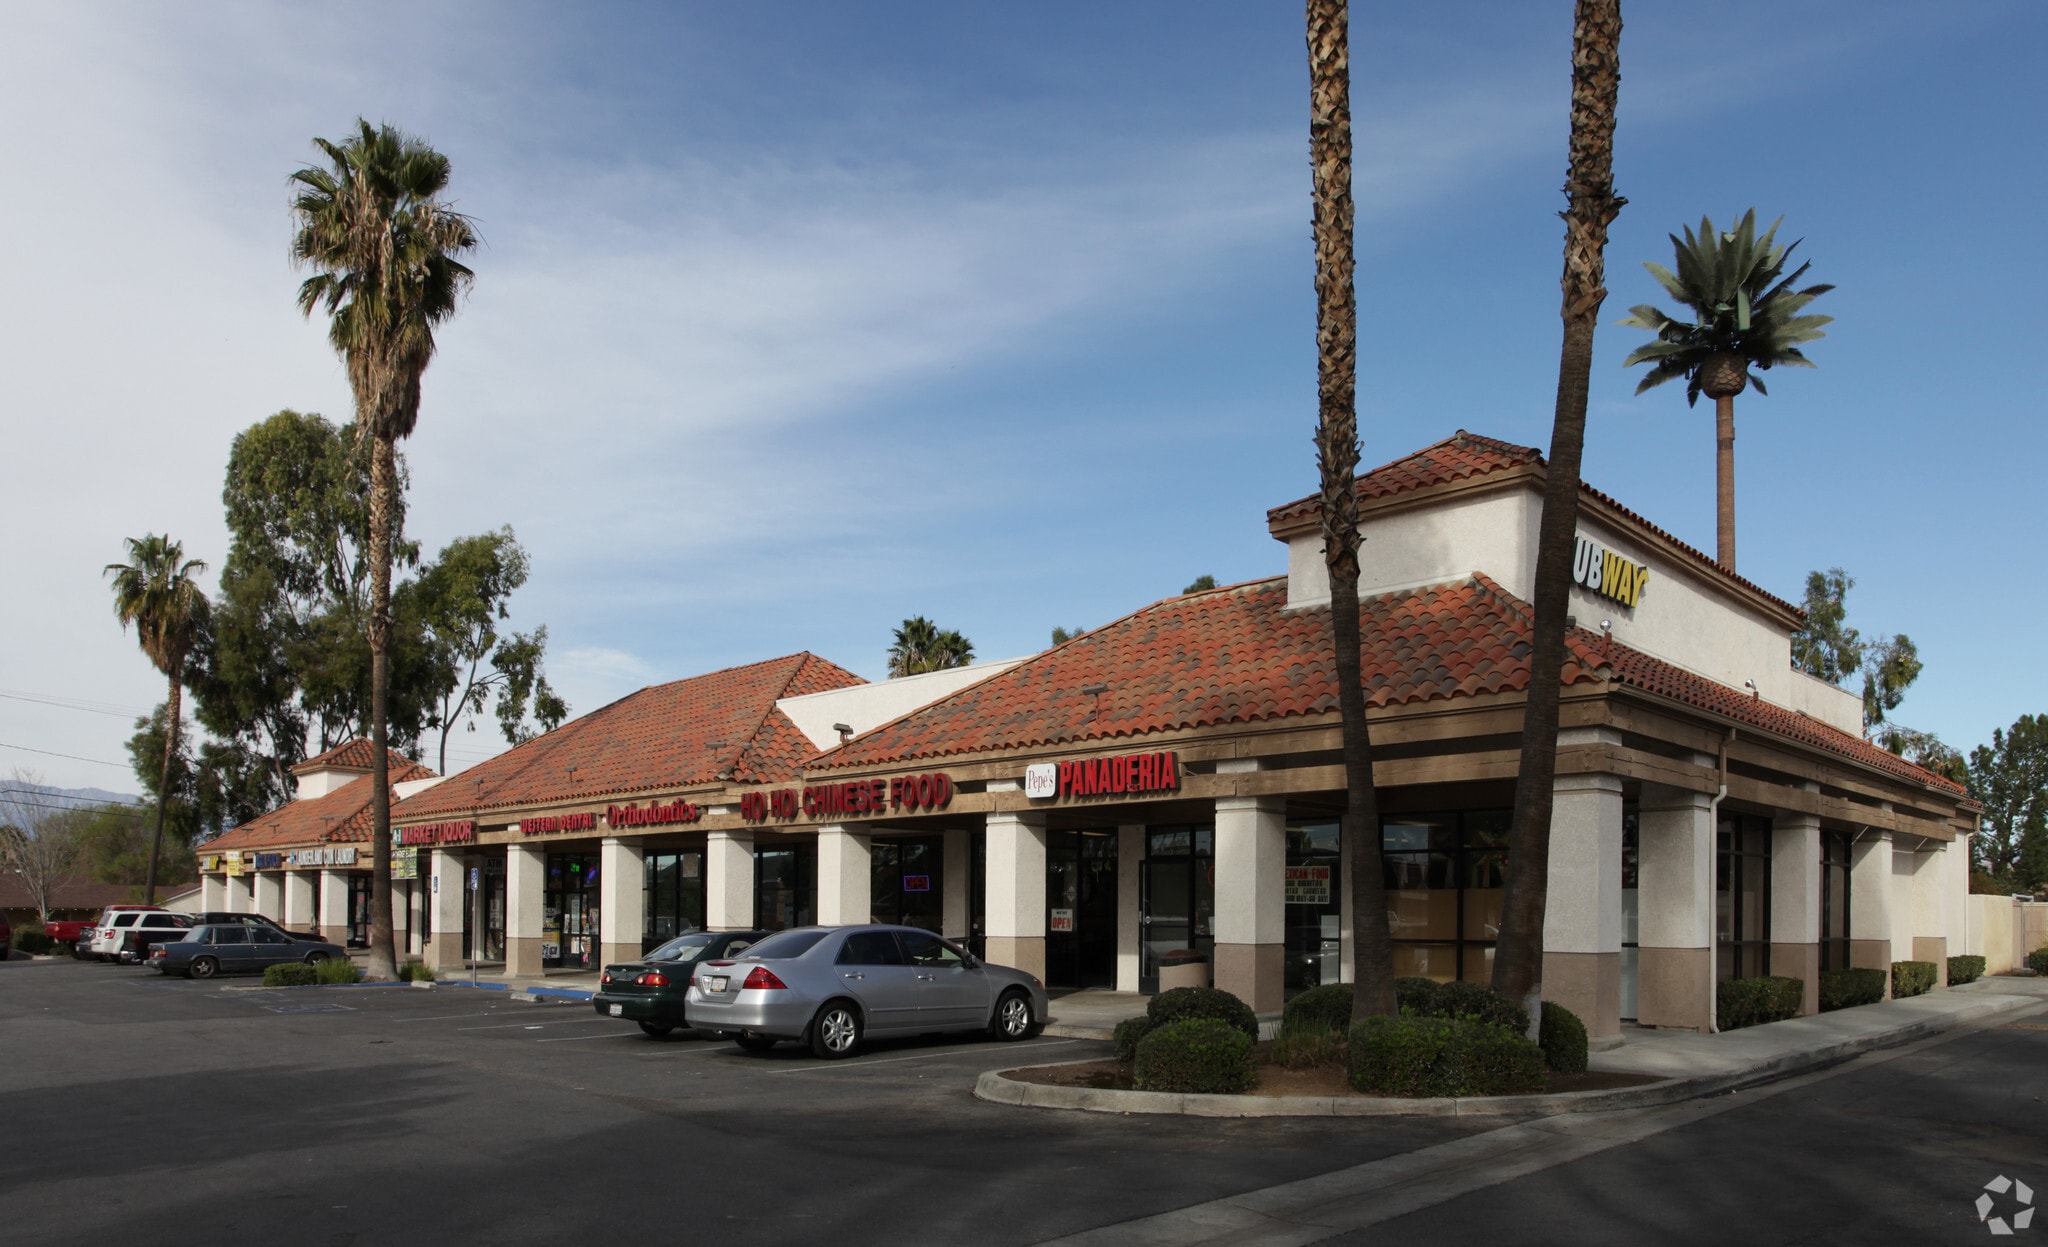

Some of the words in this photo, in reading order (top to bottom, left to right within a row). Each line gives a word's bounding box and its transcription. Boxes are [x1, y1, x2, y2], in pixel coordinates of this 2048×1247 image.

[1573, 536, 1650, 608] UBWAY
[1028, 768, 1054, 792] Pepe's
[1060, 751, 1176, 796] PANADERIA
[741, 791, 764, 820] HO
[770, 788, 795, 818] HO
[802, 778, 883, 815] CHINESE
[890, 772, 948, 809] FOOD
[520, 816, 557, 833] WESTERN
[559, 812, 593, 830] DENTAL
[605, 797, 697, 827] Orthodontics
[402, 823, 437, 845] MARKET
[438, 821, 473, 843] LIQUOR
[905, 877, 928, 889] OPEN
[1286, 867, 1308, 880] EXICAN
[1052, 917, 1072, 929] OPEN
